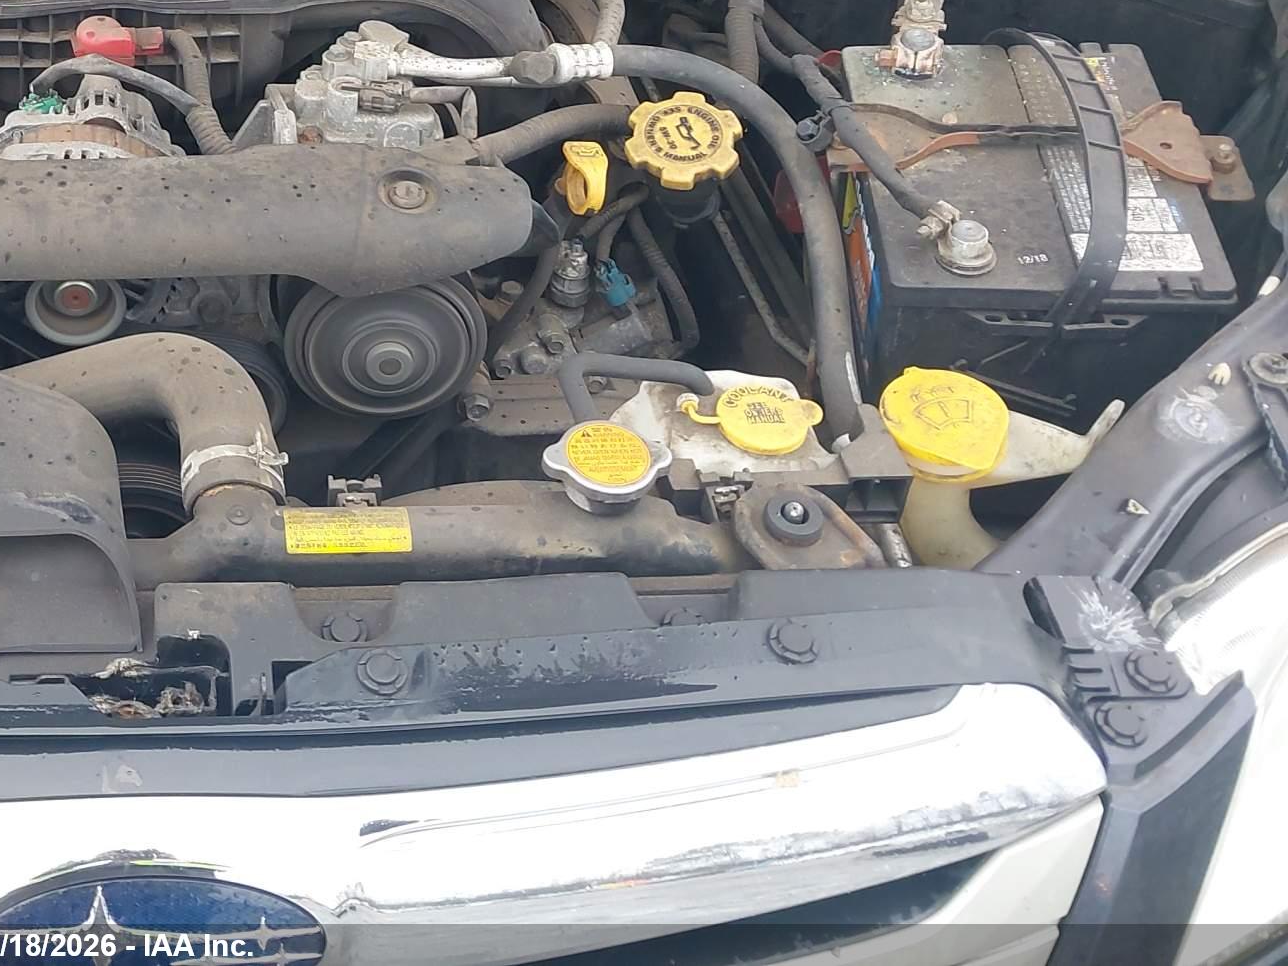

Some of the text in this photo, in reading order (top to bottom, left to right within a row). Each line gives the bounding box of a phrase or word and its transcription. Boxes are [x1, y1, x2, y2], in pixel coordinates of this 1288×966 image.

[687, 106, 720, 149] ENGINE OIL
[664, 151, 708, 161] MANUAL
[723, 385, 794, 408] COOLANT
[746, 414, 786, 424] MANUAL
